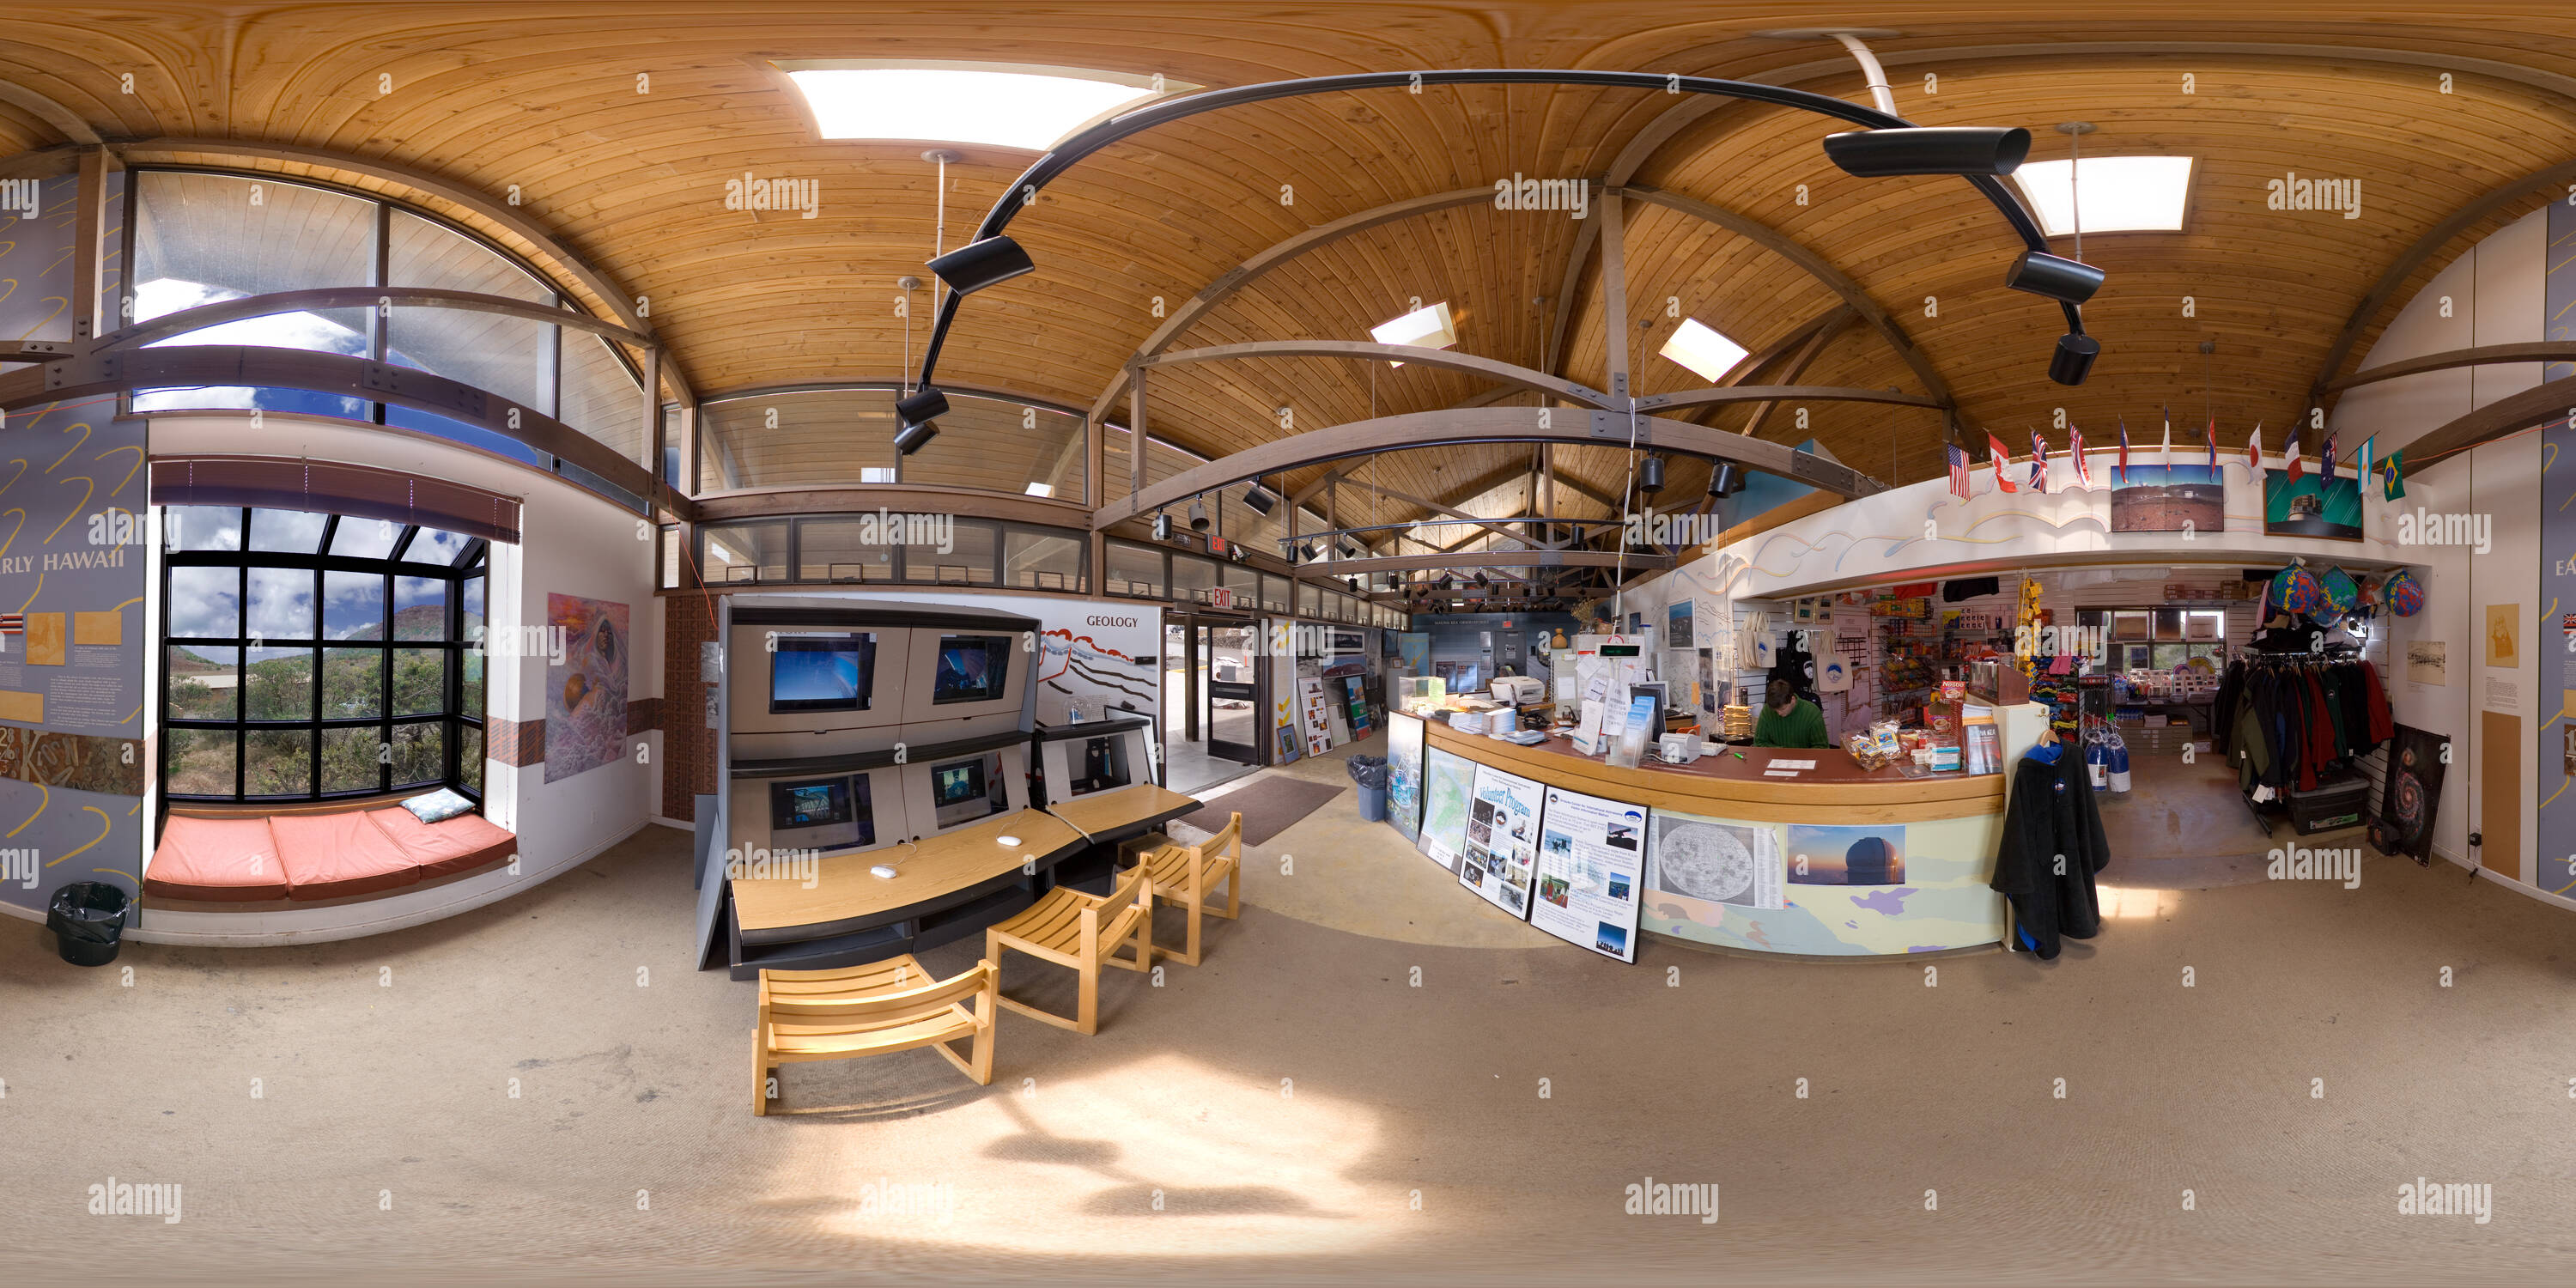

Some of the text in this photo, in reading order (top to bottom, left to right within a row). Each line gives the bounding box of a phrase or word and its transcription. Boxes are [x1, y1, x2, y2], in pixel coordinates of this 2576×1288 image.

[1212, 536, 1225, 552] EXIT
[0, 549, 125, 574] RLY HAWAII
[1214, 588, 1230, 607] EXIT
[1086, 615, 1139, 628] GEOLOGY
[1479, 785, 1530, 818] Volunteer Program
